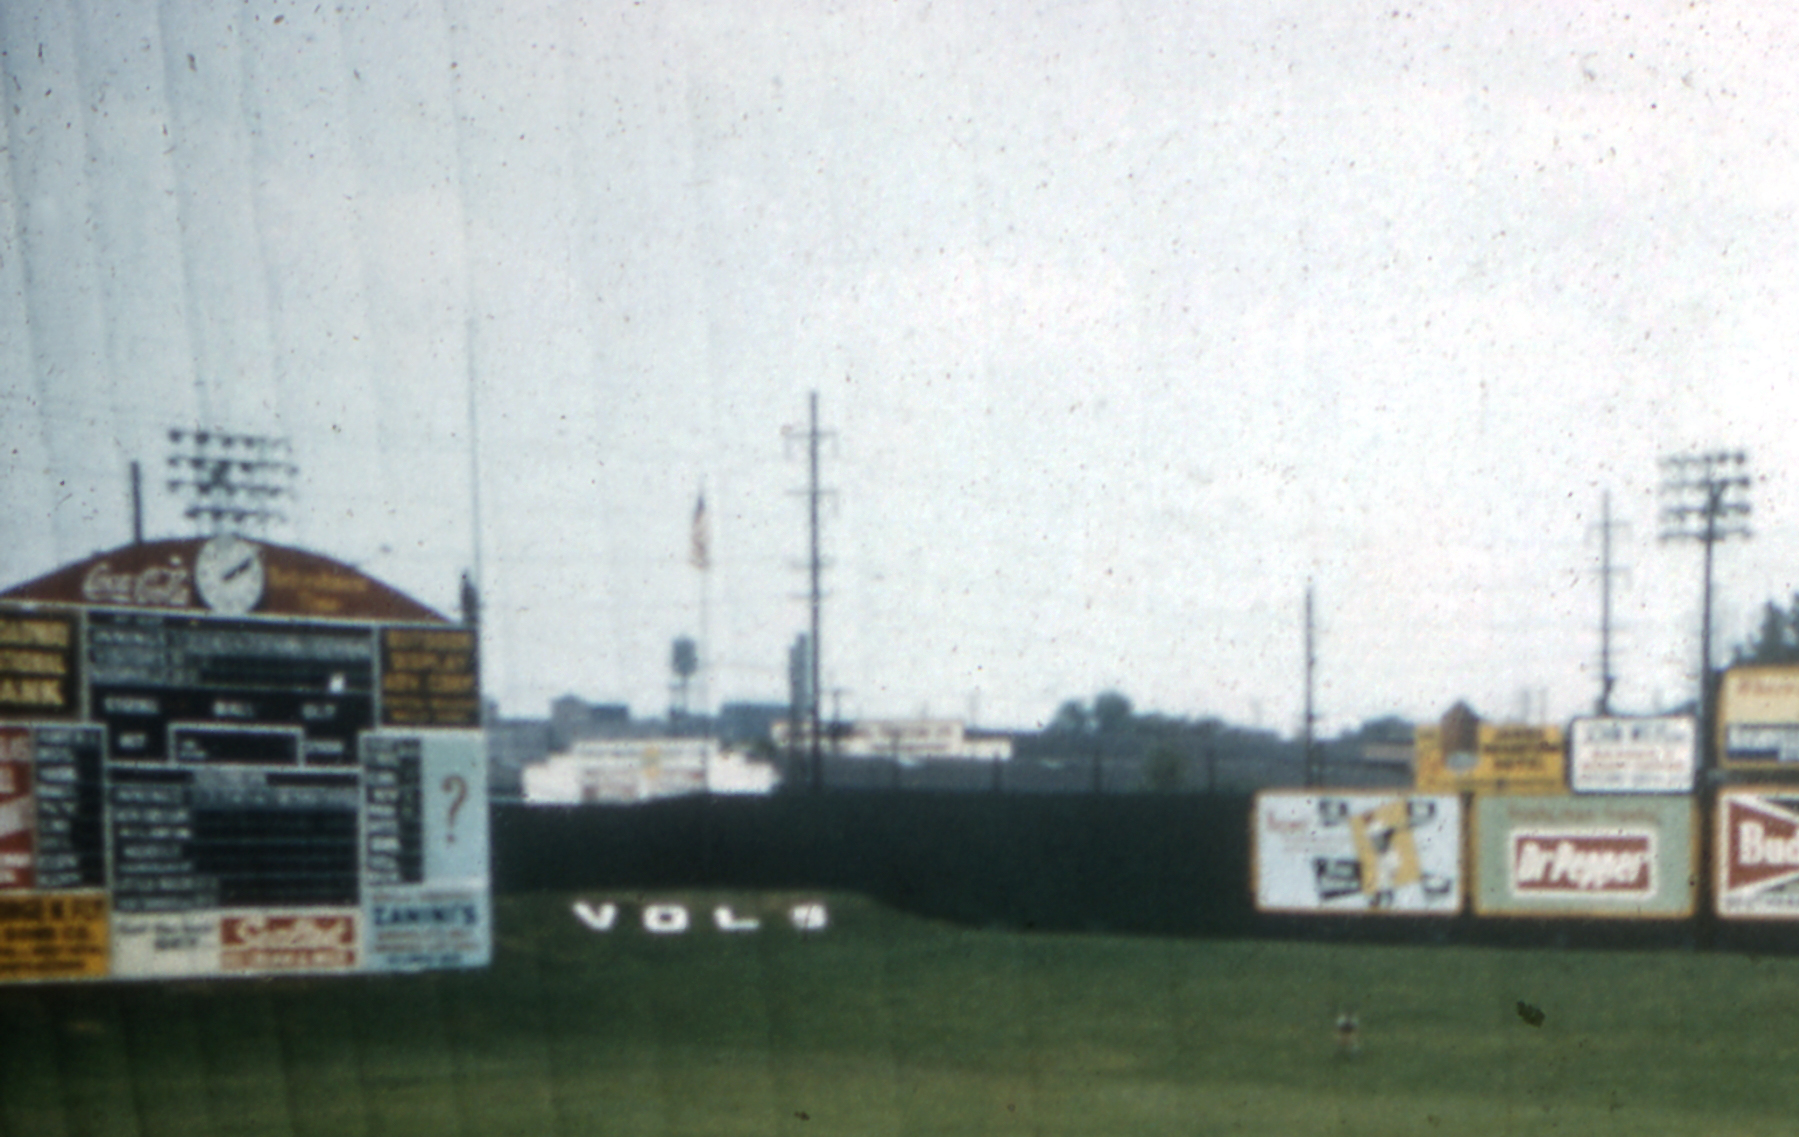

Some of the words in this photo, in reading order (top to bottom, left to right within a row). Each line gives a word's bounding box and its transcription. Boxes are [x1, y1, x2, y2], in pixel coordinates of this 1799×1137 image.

[1517, 841, 1556, 883] Dr
[1553, 839, 1649, 891] Pepper
[571, 900, 829, 934] VOLS
